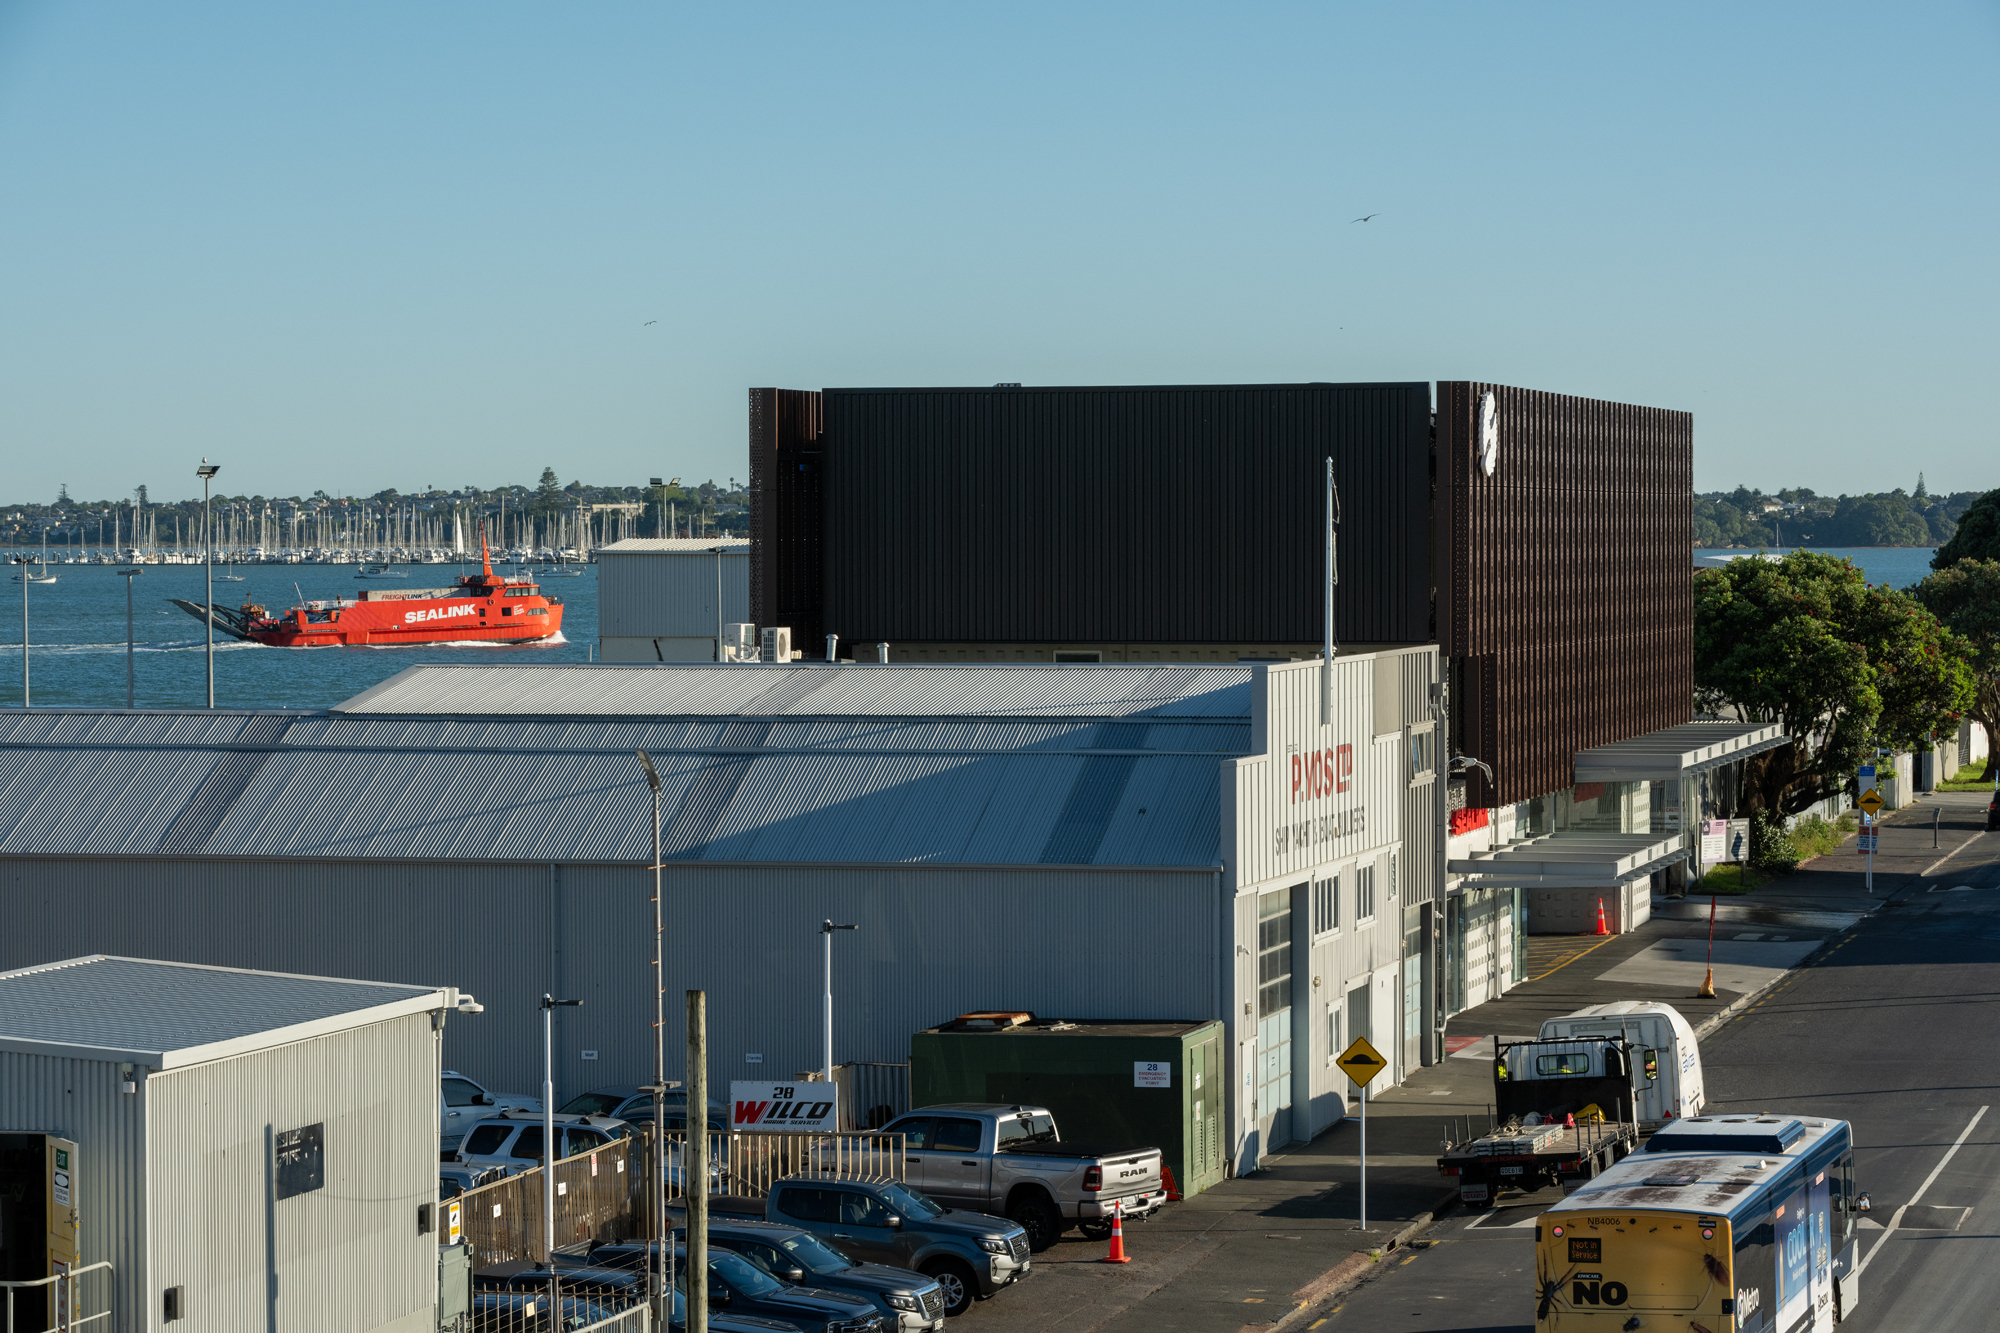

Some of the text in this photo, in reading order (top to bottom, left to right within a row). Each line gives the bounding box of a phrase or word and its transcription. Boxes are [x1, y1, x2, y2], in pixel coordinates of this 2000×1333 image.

[404, 603, 476, 624] SEALINK
[1275, 825, 1289, 856] SHIP
[1292, 820, 1310, 850] YACHT
[1320, 813, 1335, 843] BOAT
[1147, 1063, 1158, 1071] 28
[772, 1087, 795, 1099] 28
[734, 1100, 834, 1124] WILCO
[1499, 1154, 1538, 1162] SCAFFOLDING
[1120, 1167, 1148, 1178] RAM
[1587, 1217, 1621, 1225] NB4006
[1572, 1241, 1597, 1249] Not in
[1787, 1212, 1815, 1269] COOLR
[1571, 1250, 1598, 1259] Service
[1573, 1281, 1628, 1306] NO
[1744, 1287, 1760, 1319] Metro
